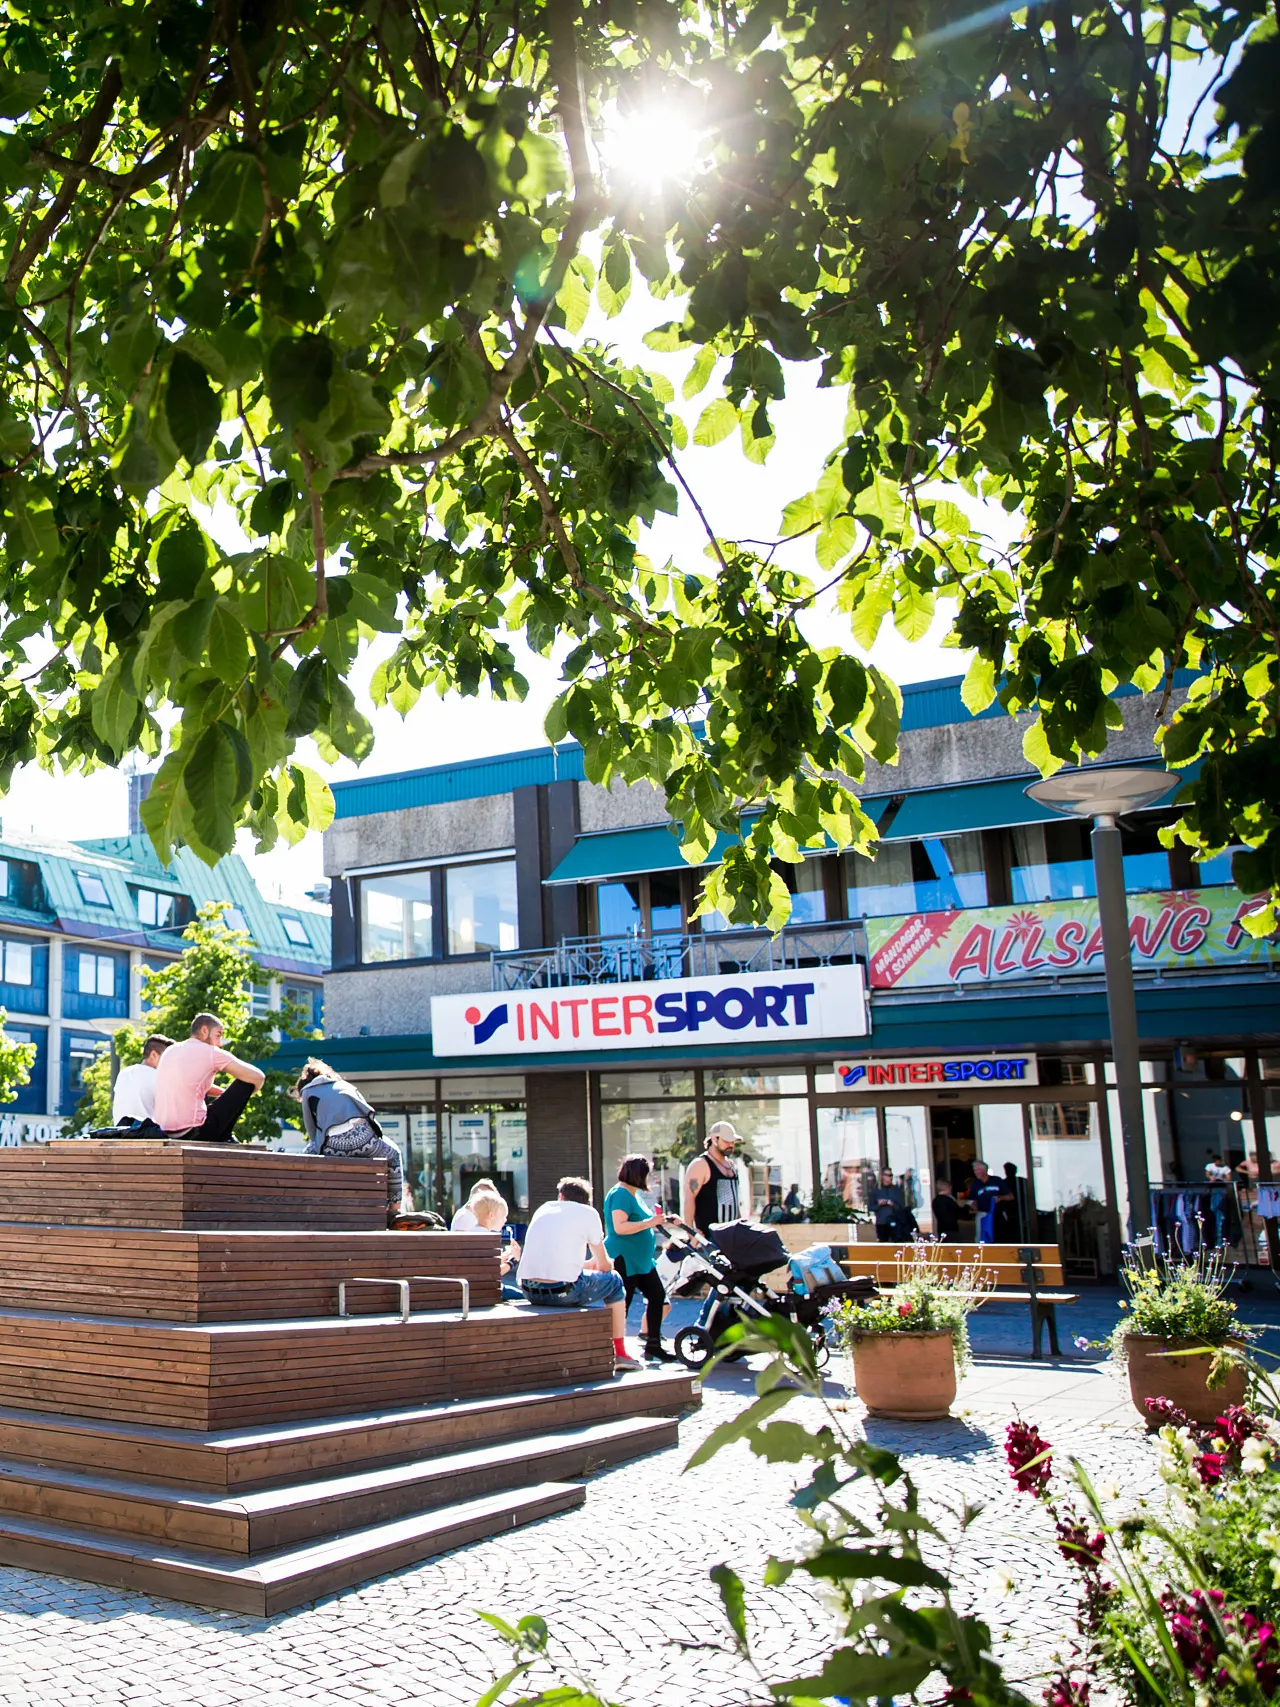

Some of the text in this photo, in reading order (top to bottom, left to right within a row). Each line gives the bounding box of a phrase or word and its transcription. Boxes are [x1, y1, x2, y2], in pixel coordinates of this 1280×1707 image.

[875, 919, 924, 975] MÅNDAGAR
[885, 928, 934, 982] I SOMMAR
[517, 983, 815, 1041] INTERSPORT
[868, 1059, 1028, 1085] INTERSPORT
